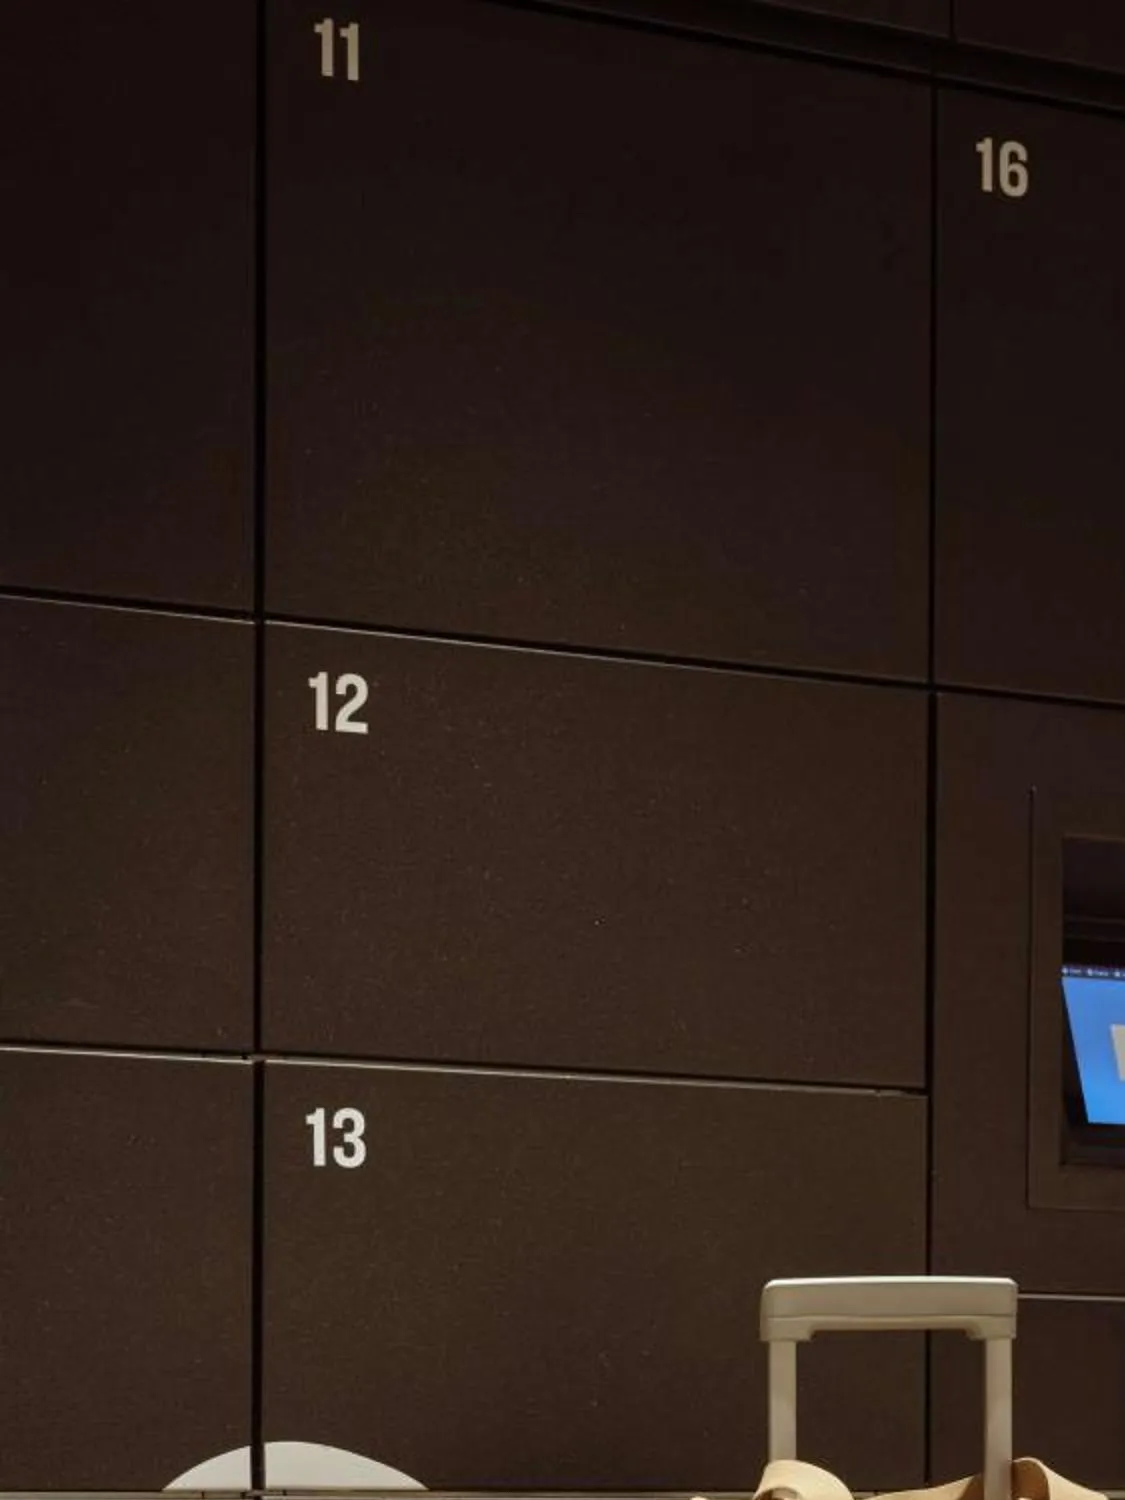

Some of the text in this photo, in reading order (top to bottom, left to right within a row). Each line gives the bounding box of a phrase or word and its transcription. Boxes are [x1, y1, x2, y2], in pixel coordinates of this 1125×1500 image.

[314, 18, 359, 81] 11
[975, 137, 1029, 197] 16
[308, 671, 369, 734] 12
[305, 1107, 366, 1169] 13
